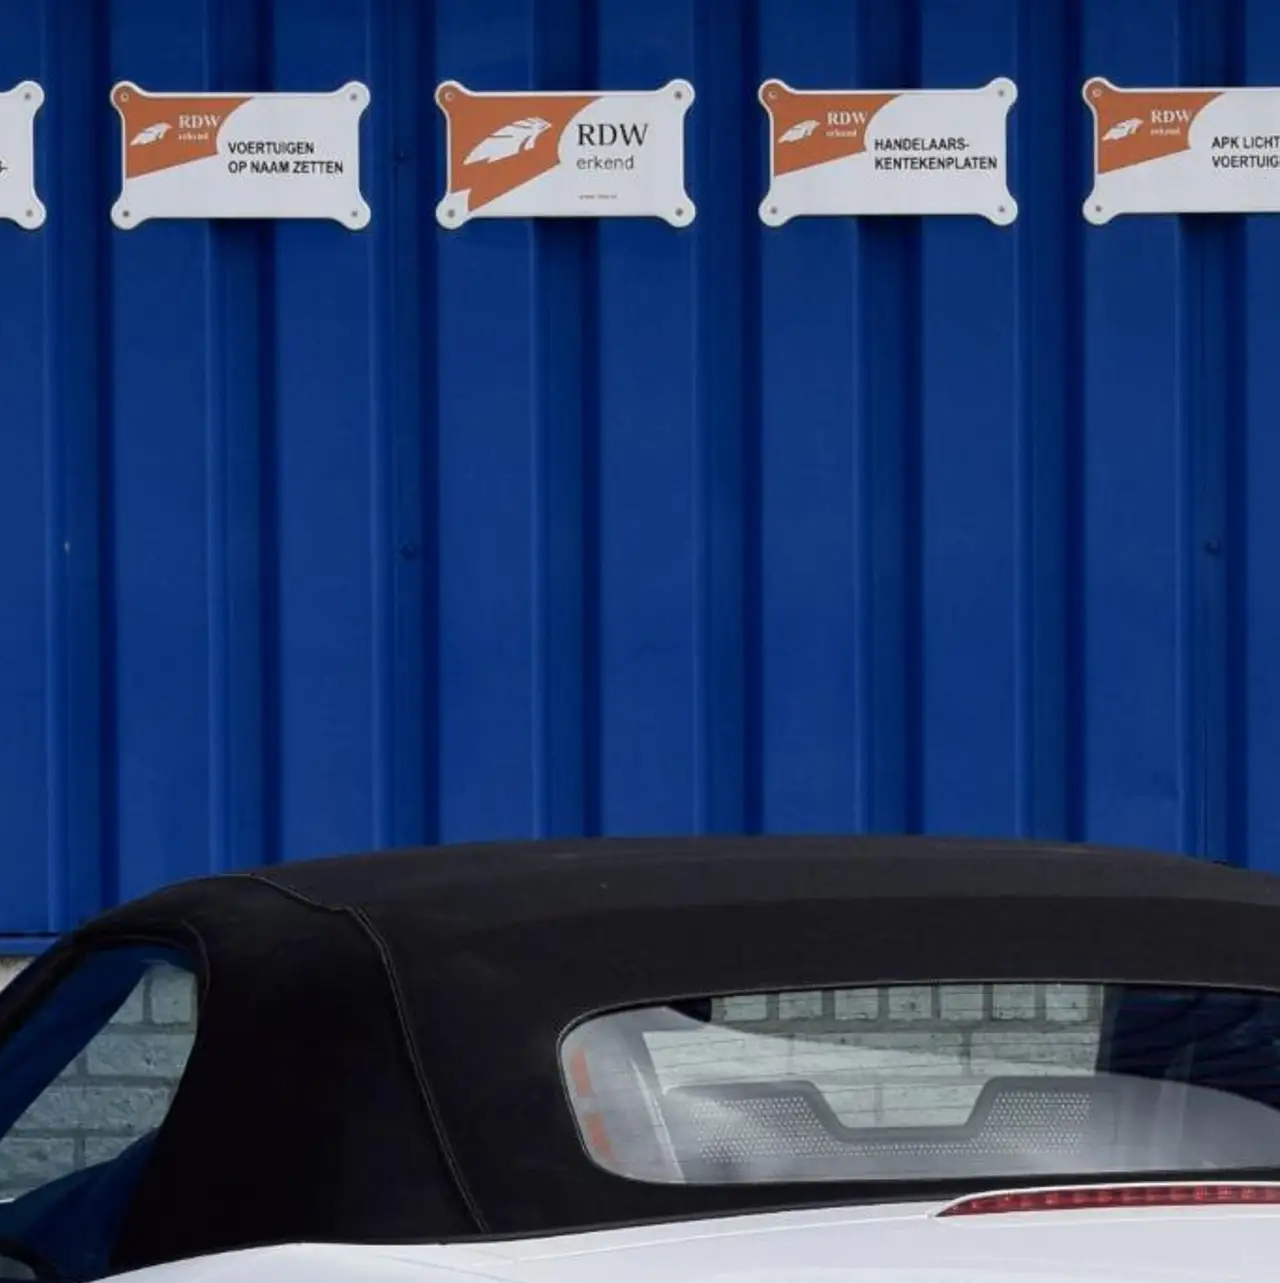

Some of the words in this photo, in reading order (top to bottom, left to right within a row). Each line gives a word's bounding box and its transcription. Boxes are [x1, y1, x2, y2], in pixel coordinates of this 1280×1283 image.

[178, 114, 220, 129] RDW
[826, 111, 868, 125] RDW
[1151, 109, 1193, 124] RDW
[578, 123, 649, 147] RDW
[228, 142, 315, 155] VOERTUIGEN
[874, 138, 970, 151] HANDELAARS-
[1211, 136, 1239, 149] APK
[228, 162, 247, 174] OP
[250, 162, 289, 174] NAAM
[293, 161, 344, 174] ZETTEN
[576, 155, 635, 170] erkend
[874, 157, 998, 170] KENTEKENPLATEN
